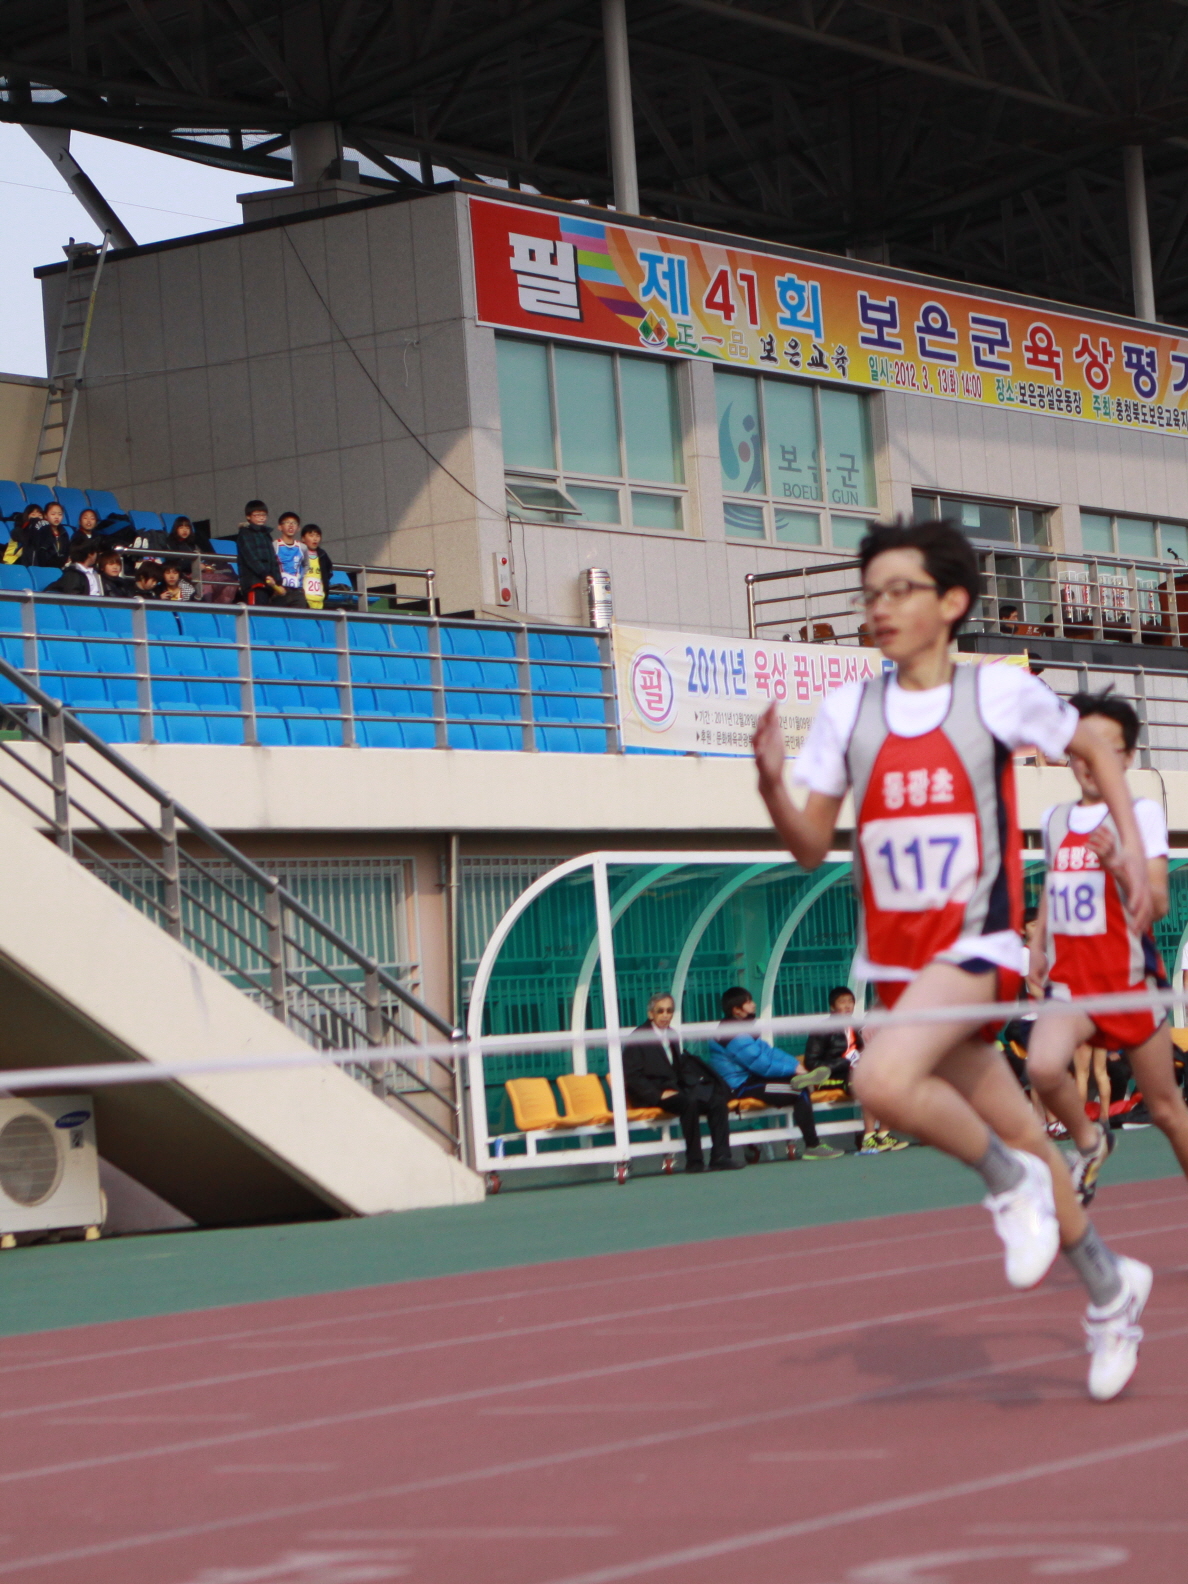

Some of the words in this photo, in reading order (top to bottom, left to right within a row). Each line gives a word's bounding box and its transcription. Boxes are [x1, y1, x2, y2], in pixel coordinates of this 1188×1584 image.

[508, 232, 581, 320] 필
[639, 250, 822, 341] 제41회
[760, 335, 849, 378] 보은교육
[961, 372, 982, 399] 14:00
[778, 443, 860, 489] 보은군
[783, 482, 819, 500] BOEU
[832, 488, 859, 506] GUN
[638, 667, 664, 712] 필
[685, 645, 748, 696] 2011년
[754, 650, 787, 700] 육상
[882, 767, 954, 810] 동광초
[878, 835, 961, 892] 117
[1049, 884, 1096, 923] 118
